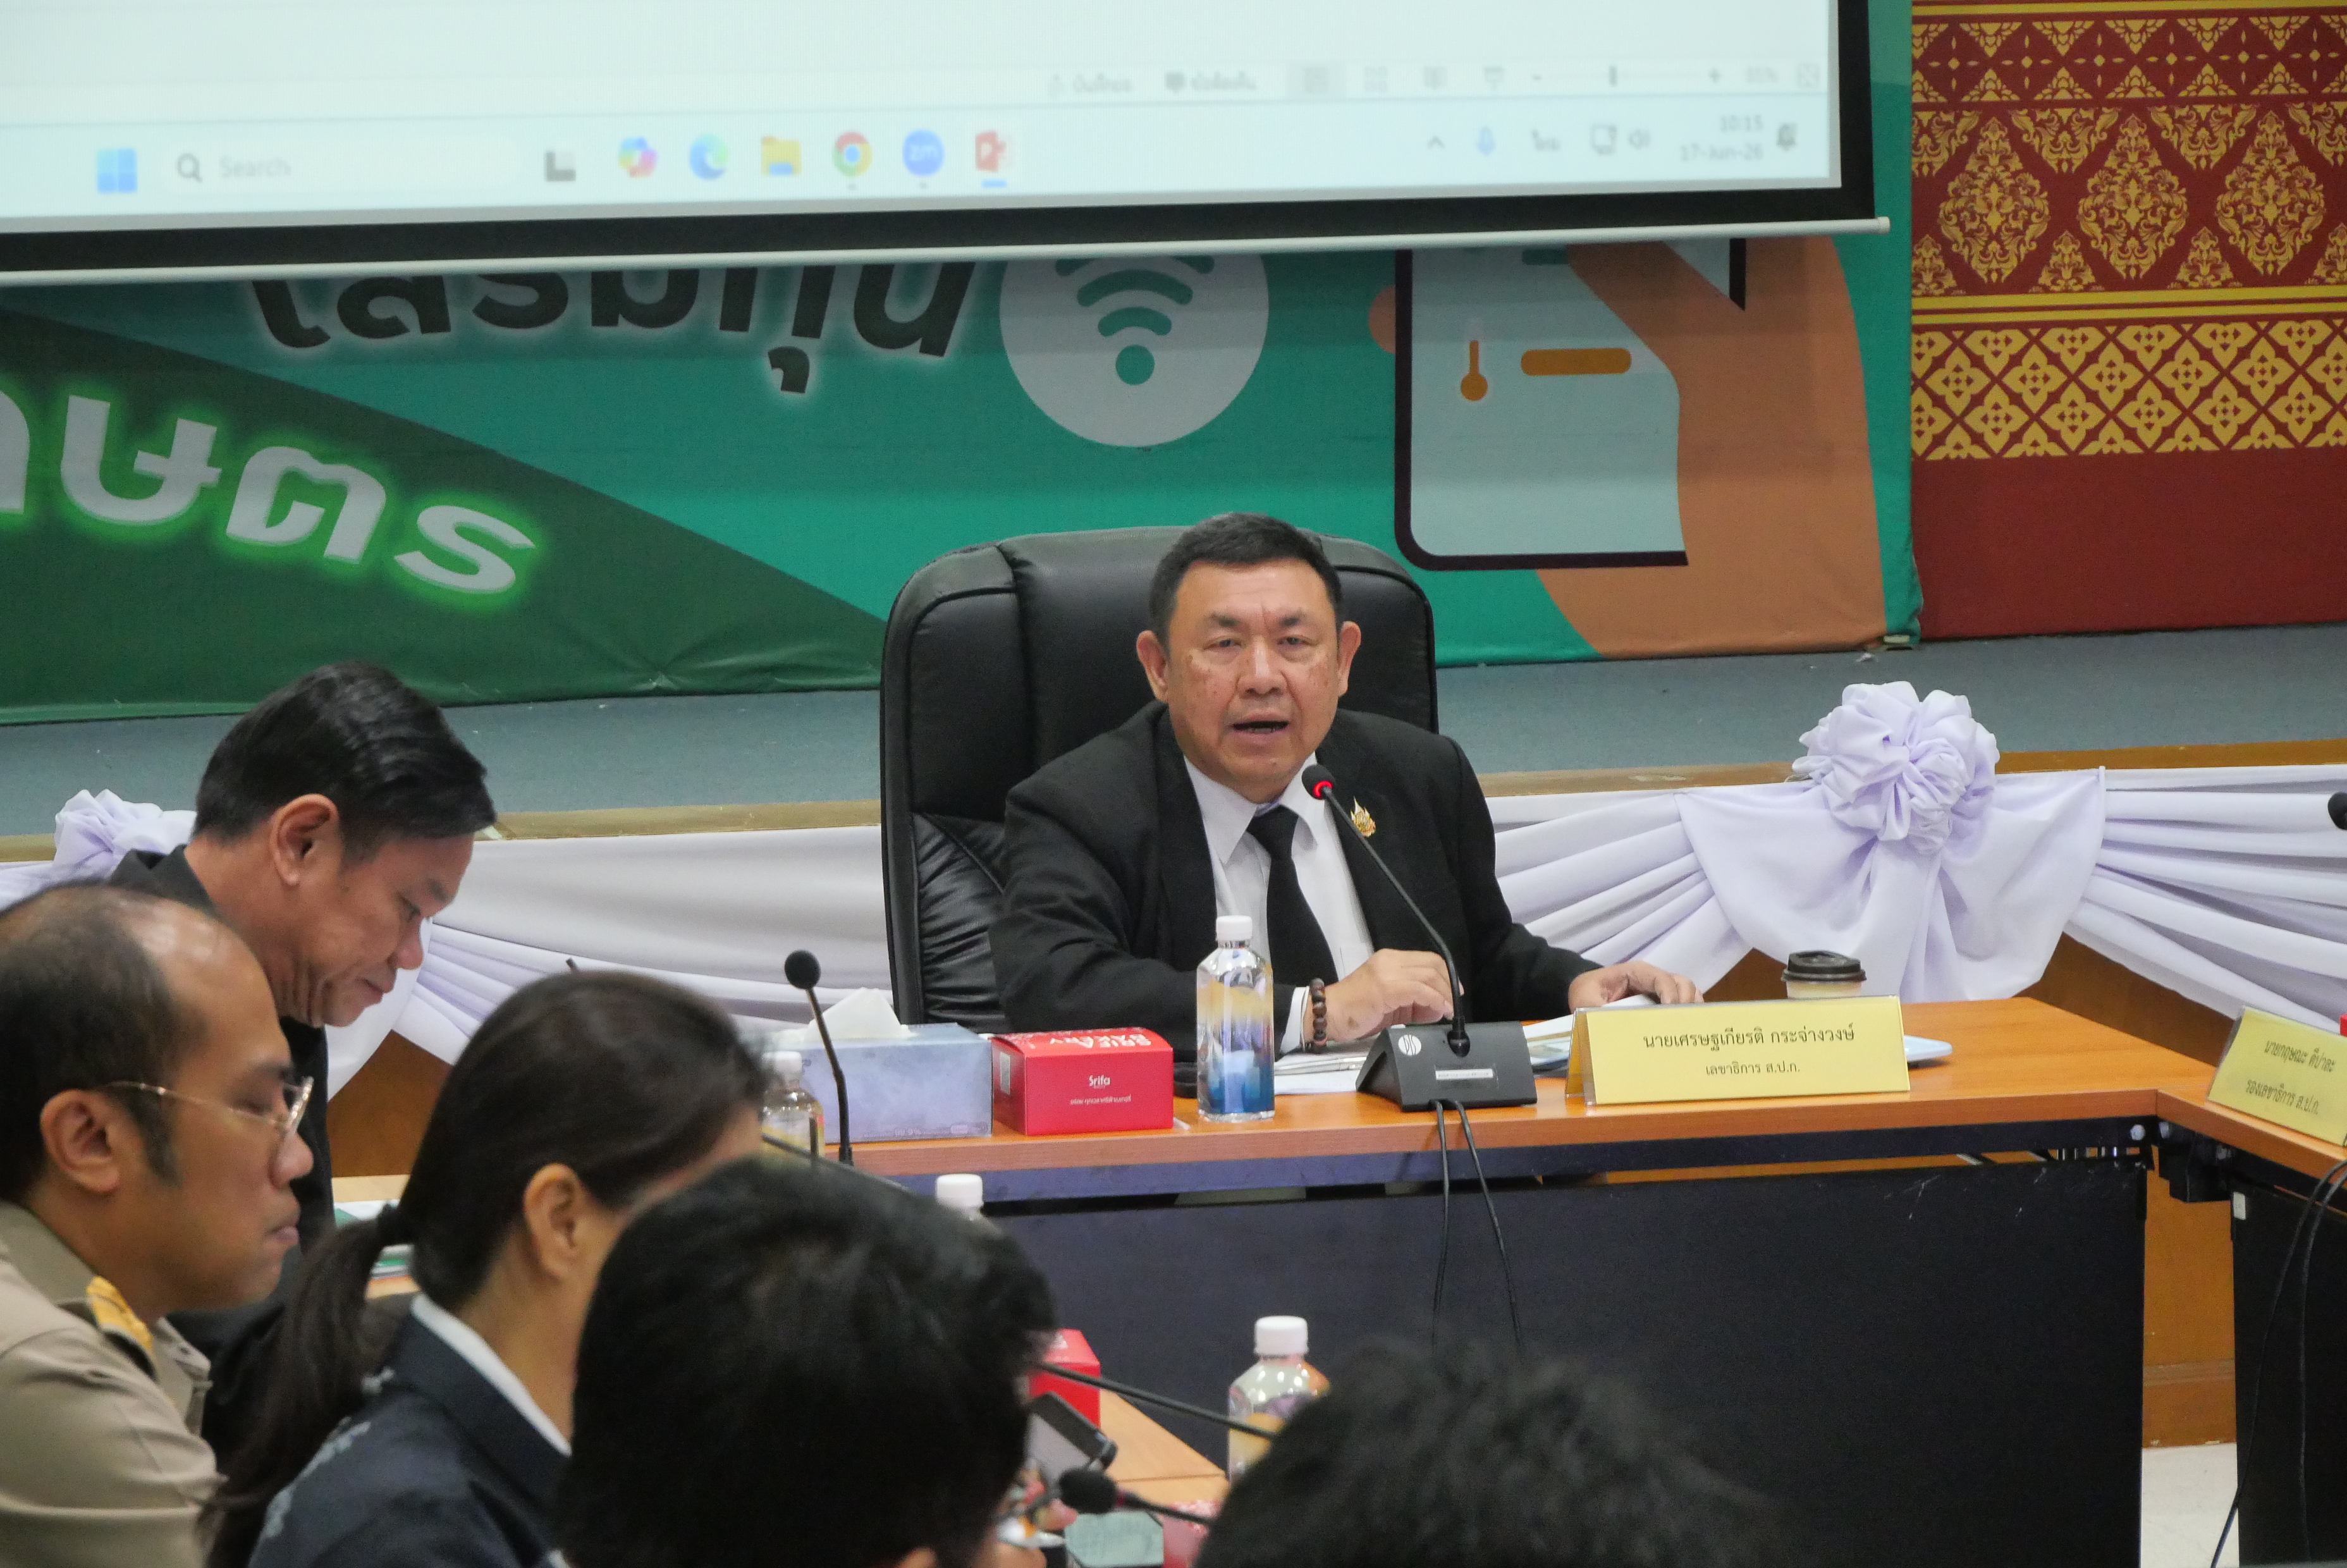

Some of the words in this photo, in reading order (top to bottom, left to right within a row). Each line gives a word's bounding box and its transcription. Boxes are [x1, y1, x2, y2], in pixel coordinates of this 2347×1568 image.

[220, 155, 292, 178] Search
[1643, 1026, 1764, 1051] นายเศรษฐเกียรติ
[1770, 1022, 1855, 1043] กระจ่างวงษ์
[1705, 1060, 1761, 1075] เลขาธิการ
[1766, 1060, 1801, 1074] ส.ป.ก.
[2246, 1079, 2296, 1106] รองเลขาธิการ
[2296, 1094, 2319, 1115] ส.ป.ก.
